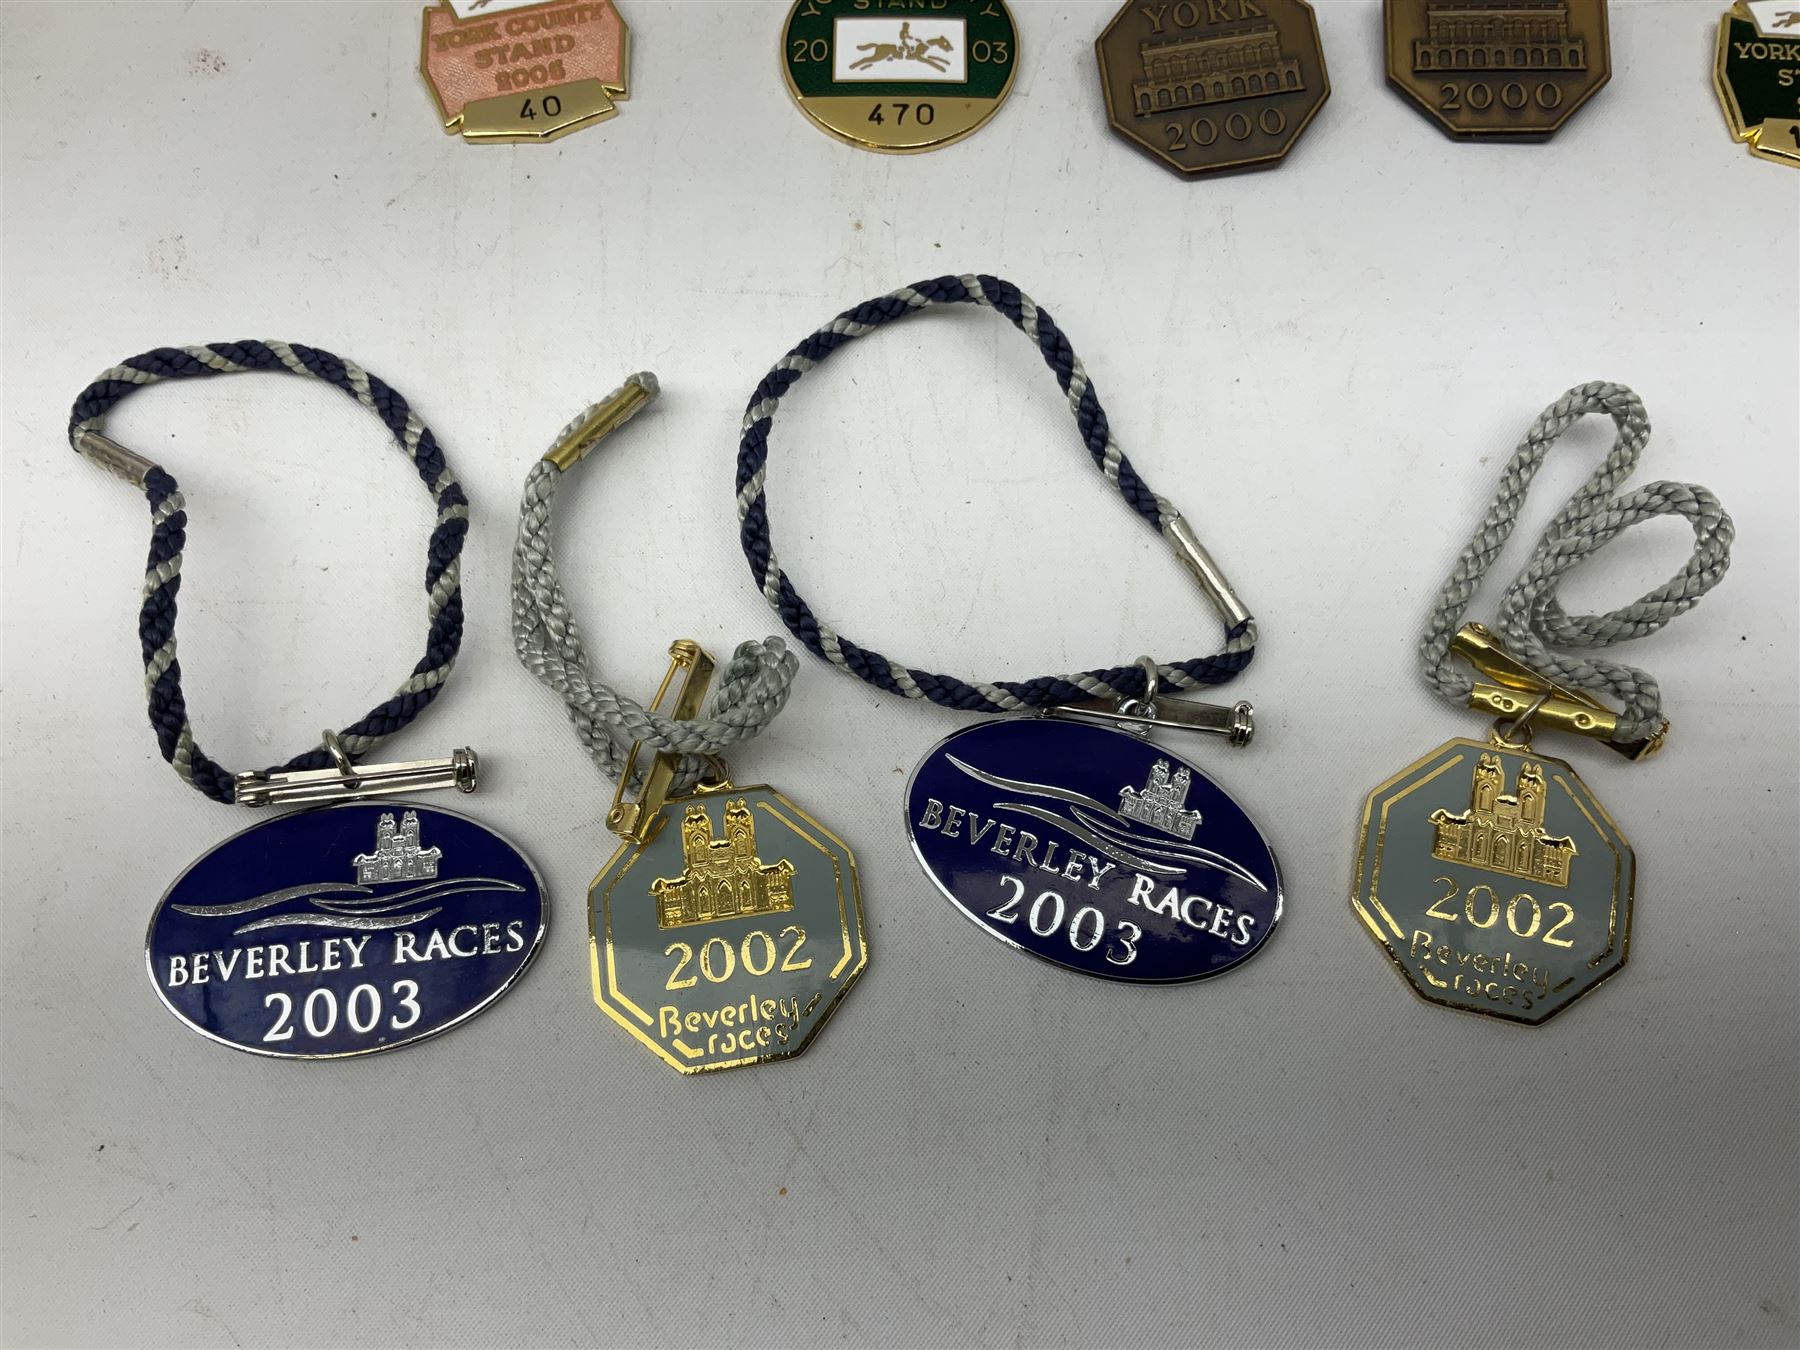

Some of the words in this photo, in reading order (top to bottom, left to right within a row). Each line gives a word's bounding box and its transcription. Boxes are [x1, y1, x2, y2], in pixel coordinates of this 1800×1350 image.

[431, 21, 503, 52] YORK
[505, 5, 604, 36] COUNTY
[1140, 0, 1268, 34] YORK
[474, 34, 575, 68] STAND
[793, 38, 829, 63] 20
[972, 40, 1008, 64] 03
[1734, 42, 1800, 61] YORK
[519, 95, 562, 120] 40
[868, 103, 934, 126] 470
[1440, 82, 1562, 110] 2000
[1165, 107, 1286, 151] 2000
[919, 798, 1117, 891] BEVERLEY
[1127, 873, 1256, 947] RACES
[986, 875, 1143, 966] 2003
[1425, 875, 1575, 948] 2002
[168, 935, 374, 988] BEVERLEY
[394, 920, 525, 965] RACES
[664, 925, 813, 991] 2002
[1410, 930, 1549, 999] Beverley
[263, 979, 421, 1042] 2003
[659, 994, 799, 1038] Beverley
[708, 1023, 791, 1054] races
